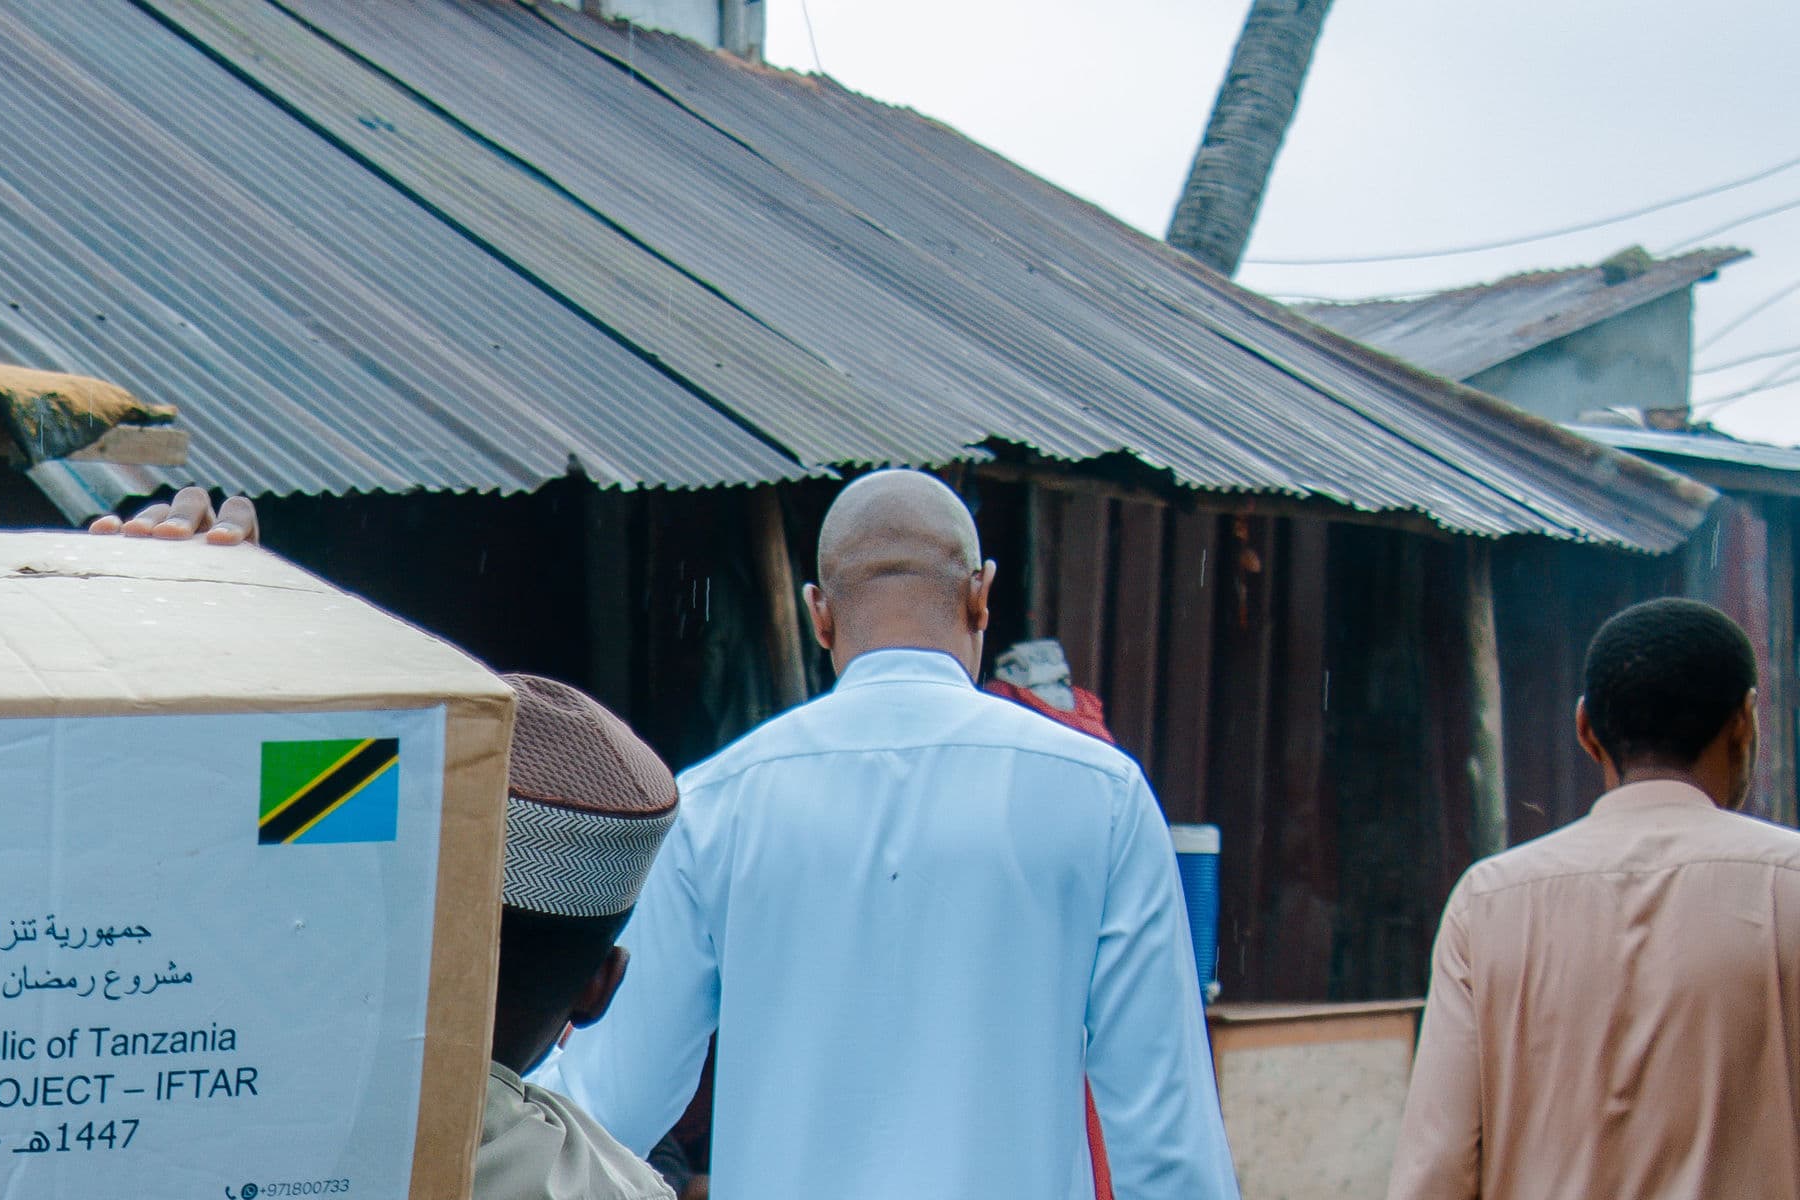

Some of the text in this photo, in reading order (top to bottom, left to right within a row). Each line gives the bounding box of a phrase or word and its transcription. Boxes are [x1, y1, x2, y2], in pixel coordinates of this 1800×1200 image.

[46, 914, 152, 949] جمهورية
[2, 965, 96, 999] رمضان
[102, 960, 194, 1001] مشروع
[46, 1029, 81, 1060] of
[88, 1022, 238, 1057] Tanzania
[156, 1067, 259, 1101] IFTAR
[259, 1178, 351, 1198] +971800733
